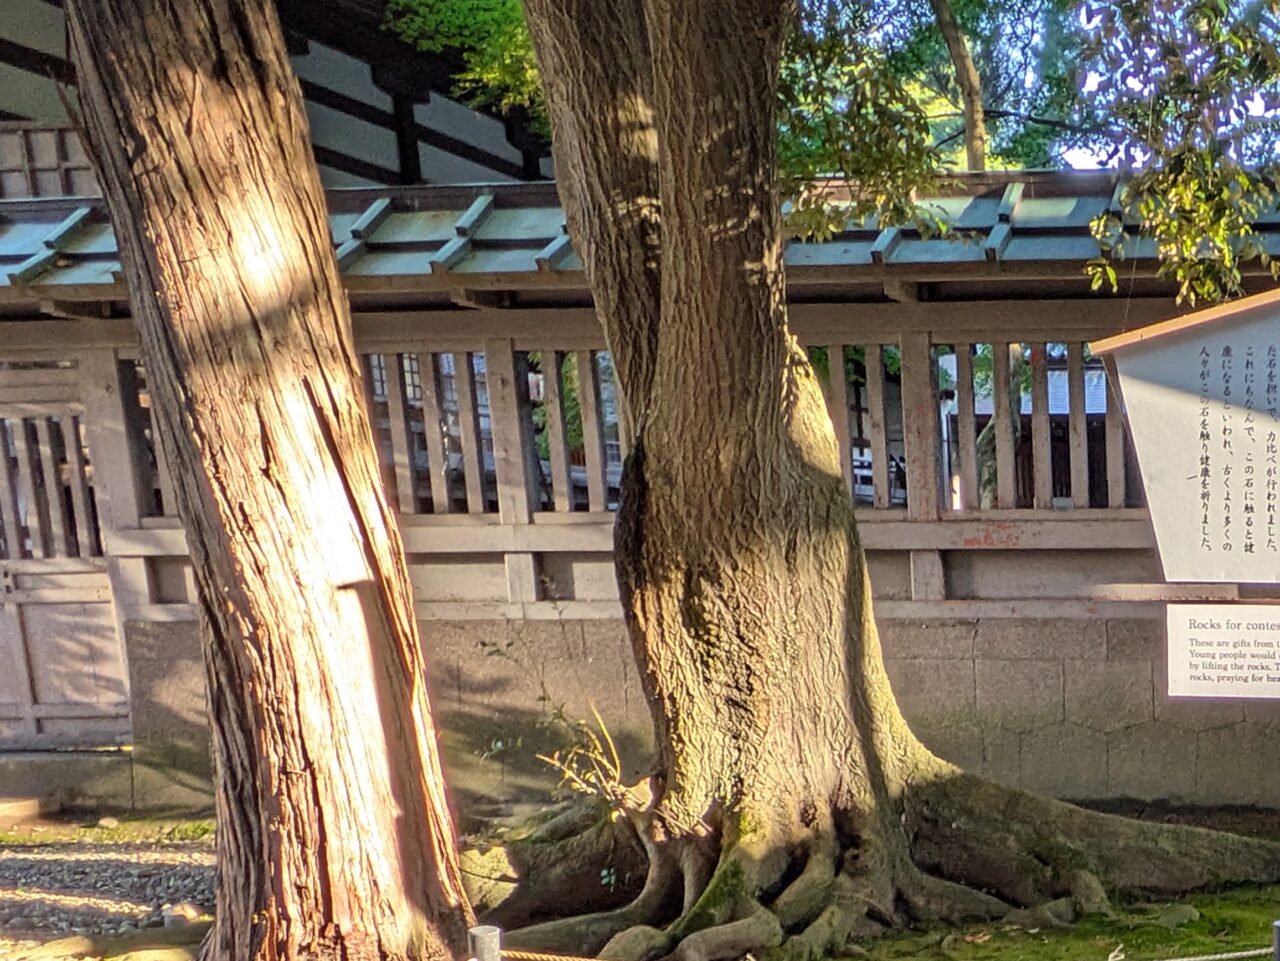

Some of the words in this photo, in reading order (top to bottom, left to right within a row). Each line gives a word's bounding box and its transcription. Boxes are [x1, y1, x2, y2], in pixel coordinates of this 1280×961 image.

[1189, 619, 1221, 629] Rocks
[1226, 619, 1241, 630] for
[1233, 639, 1250, 648] gifts
[1254, 640, 1273, 648] from
[1189, 650, 1216, 659] Young
[1219, 651, 1247, 659] people
[1189, 662, 1199, 670] by
[1202, 662, 1227, 671] lifting
[1248, 663, 1271, 671] rocks.
[1190, 673, 1214, 681] rocks,
[1217, 675, 1248, 683] praying
[1252, 674, 1263, 682] for
